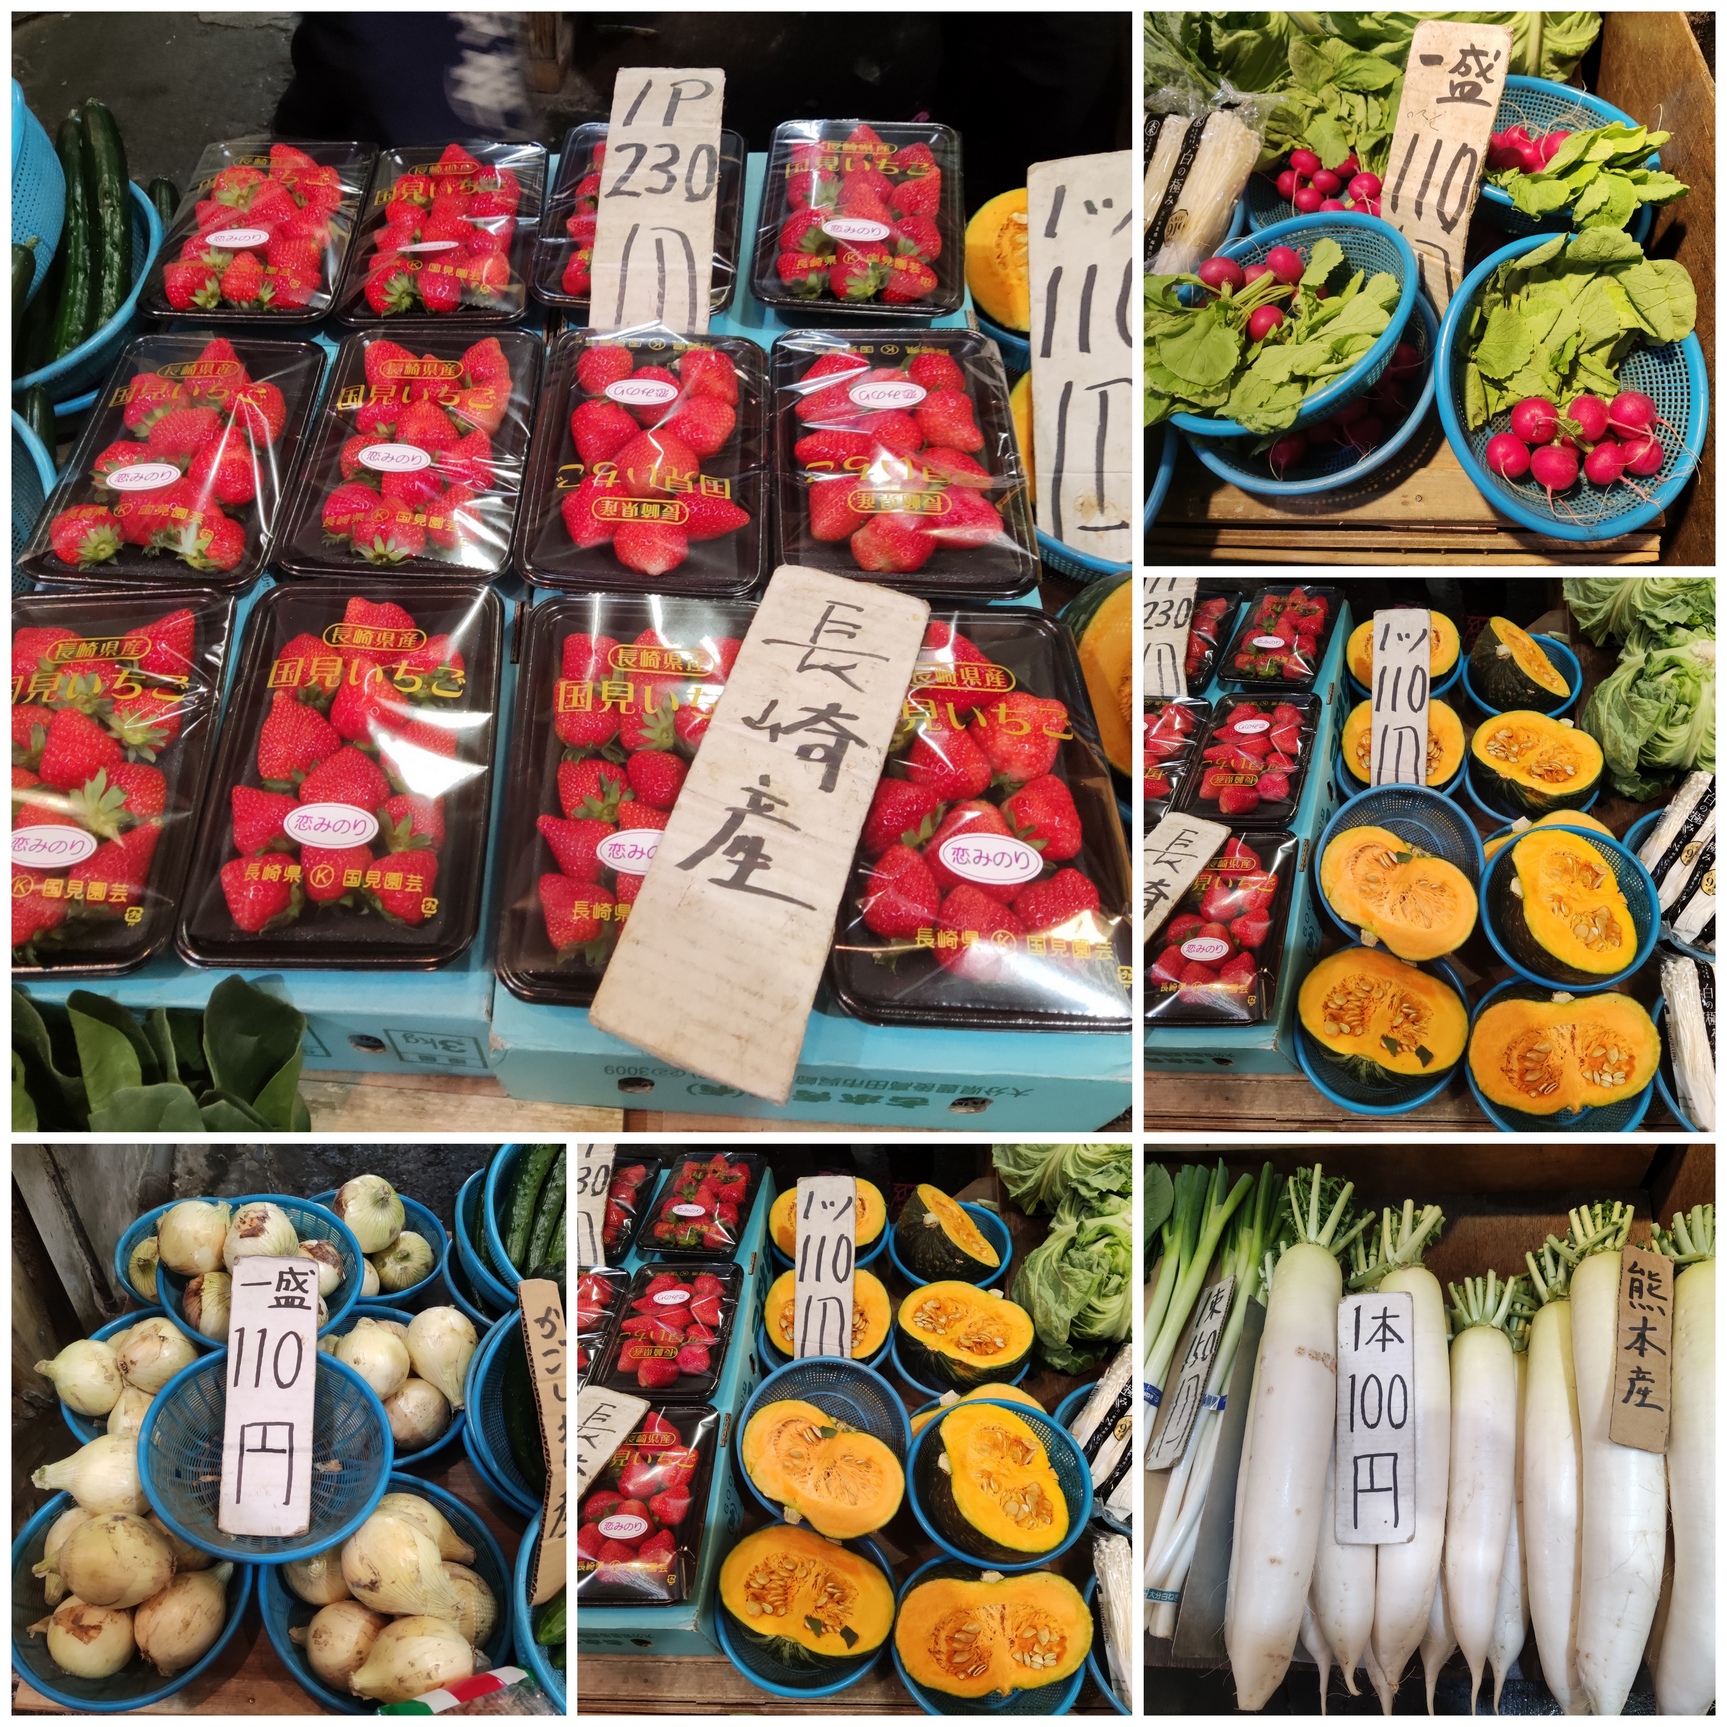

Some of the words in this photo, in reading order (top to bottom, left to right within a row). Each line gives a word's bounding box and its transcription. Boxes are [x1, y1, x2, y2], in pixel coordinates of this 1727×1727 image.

[1419, 43, 1502, 108] 一盛
[622, 79, 714, 127] 1P
[604, 143, 719, 202] 230
[1390, 132, 1479, 235] 110
[337, 384, 497, 411] 国見いちご
[114, 469, 174, 483] 恋みのり
[365, 451, 424, 466] 恋みのり
[599, 499, 681, 522] 長崎県産
[1144, 597, 1193, 629] 230
[55, 639, 149, 662] 長崎県産
[332, 627, 421, 649] 長崎県産
[266, 657, 467, 699] 国見いちご
[1375, 664, 1427, 713] 110
[12, 836, 87, 856] 恋みのり
[293, 814, 369, 836] 恋みのり
[244, 863, 302, 883] 長崎県
[342, 869, 424, 893] 国見園芸
[950, 846, 1031, 870] 恋みのり
[42, 877, 130, 903] 国見園芸
[914, 927, 980, 950] 長崎県
[402, 1031, 467, 1054] 3kg
[798, 1233, 853, 1283] 110
[240, 1266, 316, 1311] 一盛
[1353, 1304, 1405, 1352] 1本
[1621, 1260, 1669, 1413] 熊本産
[233, 1326, 303, 1389] 110
[1156, 1373, 1200, 1459] 円
[1348, 1373, 1409, 1433] 100
[235, 1421, 295, 1507] 円
[1353, 1451, 1399, 1530] 円
